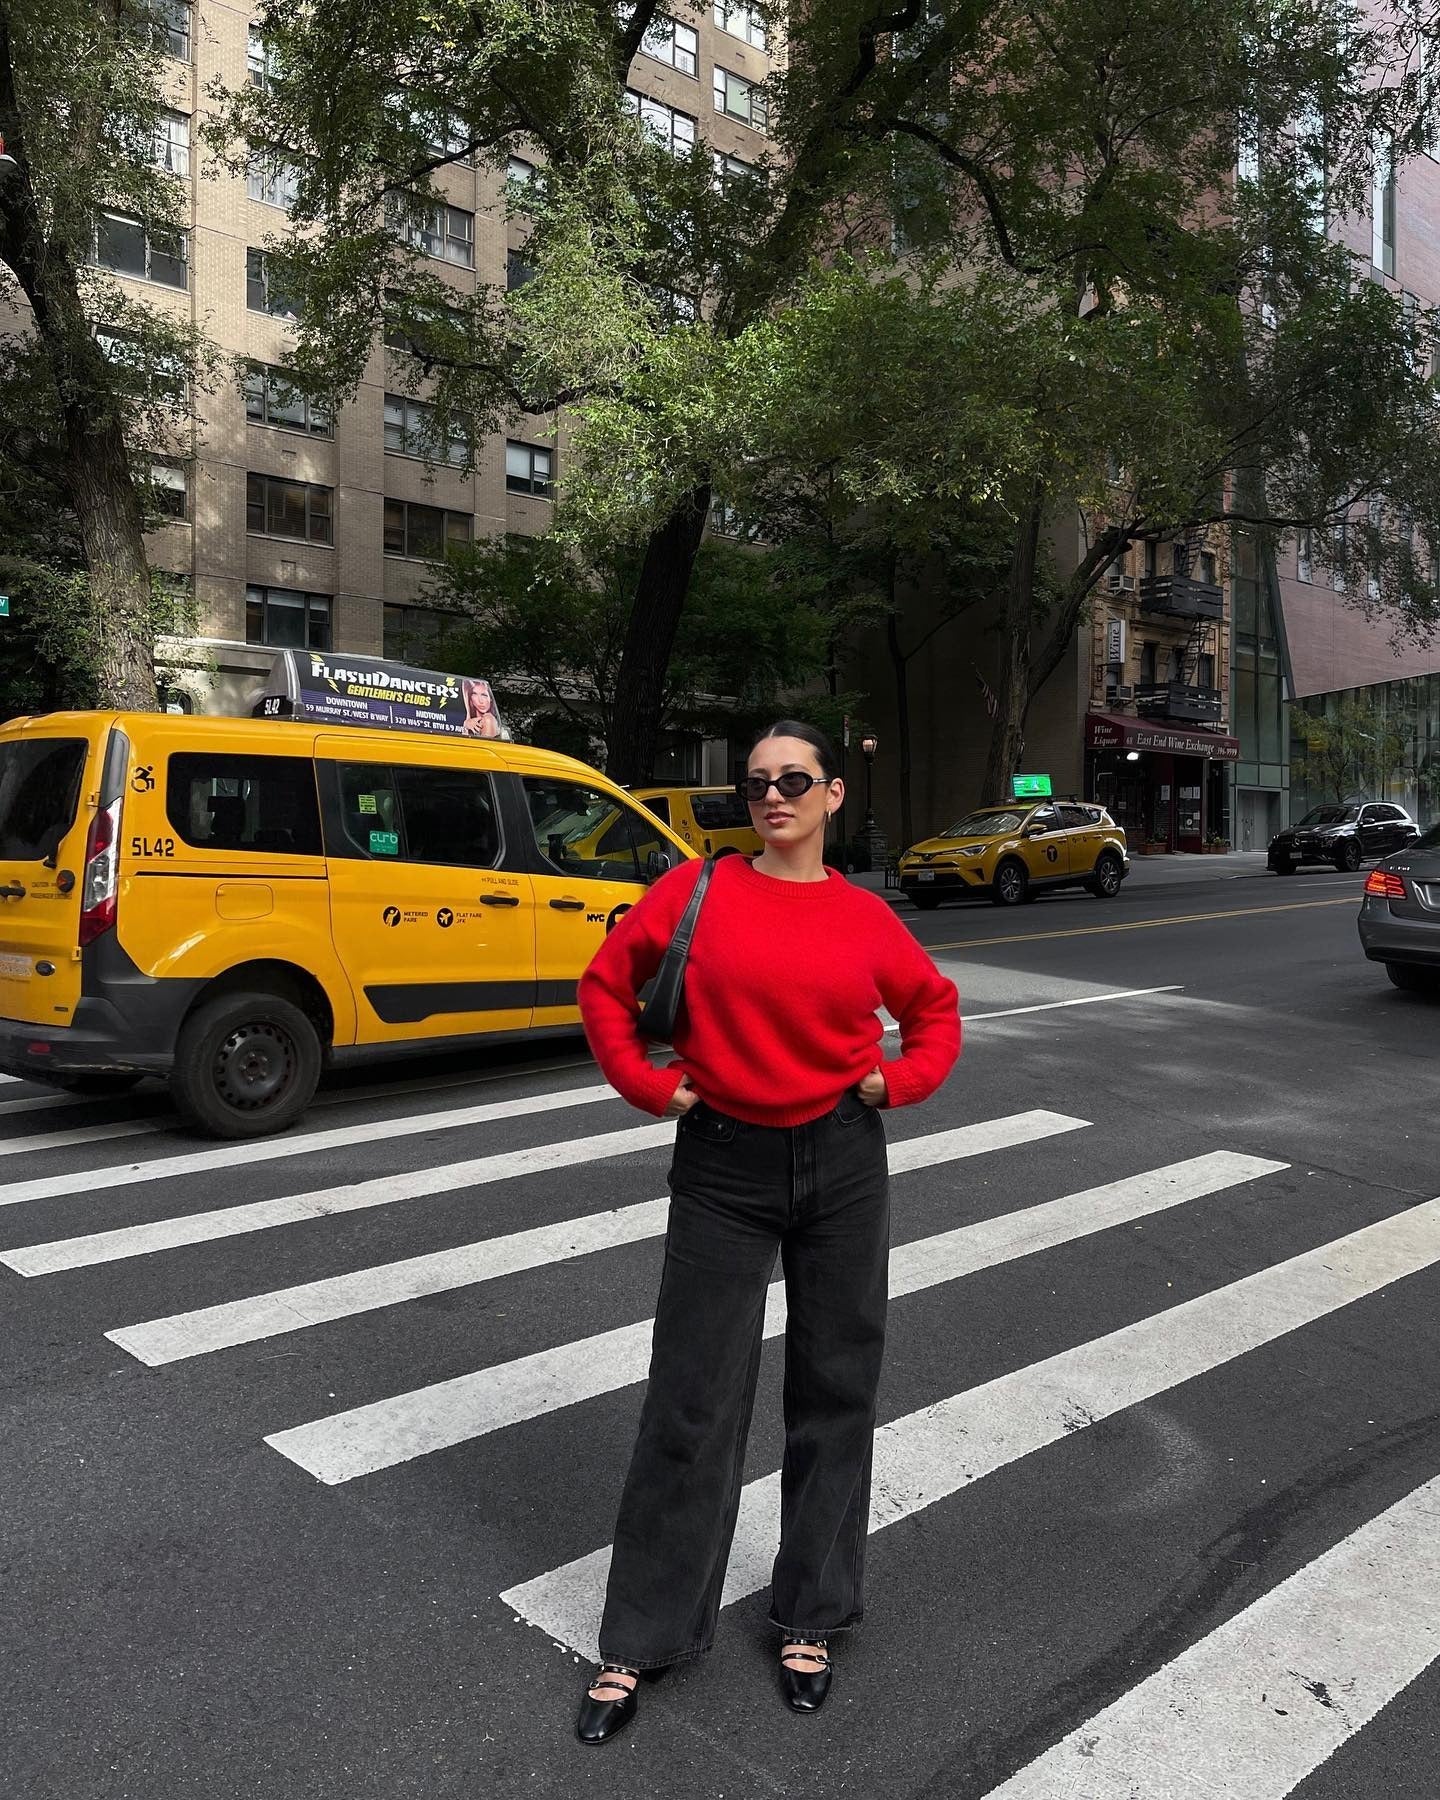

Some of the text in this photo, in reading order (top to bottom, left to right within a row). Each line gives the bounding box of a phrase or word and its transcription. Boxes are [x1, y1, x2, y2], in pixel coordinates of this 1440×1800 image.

[1109, 629, 1120, 660] Wine
[347, 684, 432, 707] GENTLEMEN'S CLUBS
[305, 703, 315, 712] 59
[315, 705, 342, 716] MURRAY
[325, 696, 368, 710] DOWNTOWN
[415, 709, 447, 722] MIDTOWN
[394, 716, 407, 725] 320
[432, 722, 445, 730] BTW
[1093, 736, 1119, 747] Liquor
[1137, 732, 1152, 746] East
[1153, 734, 1167, 748] End
[1168, 736, 1185, 750] Wine
[1185, 738, 1215, 756] Exchange
[370, 833, 398, 844] curb
[131, 837, 175, 857] 5L42
[586, 913, 605, 922] NYC
